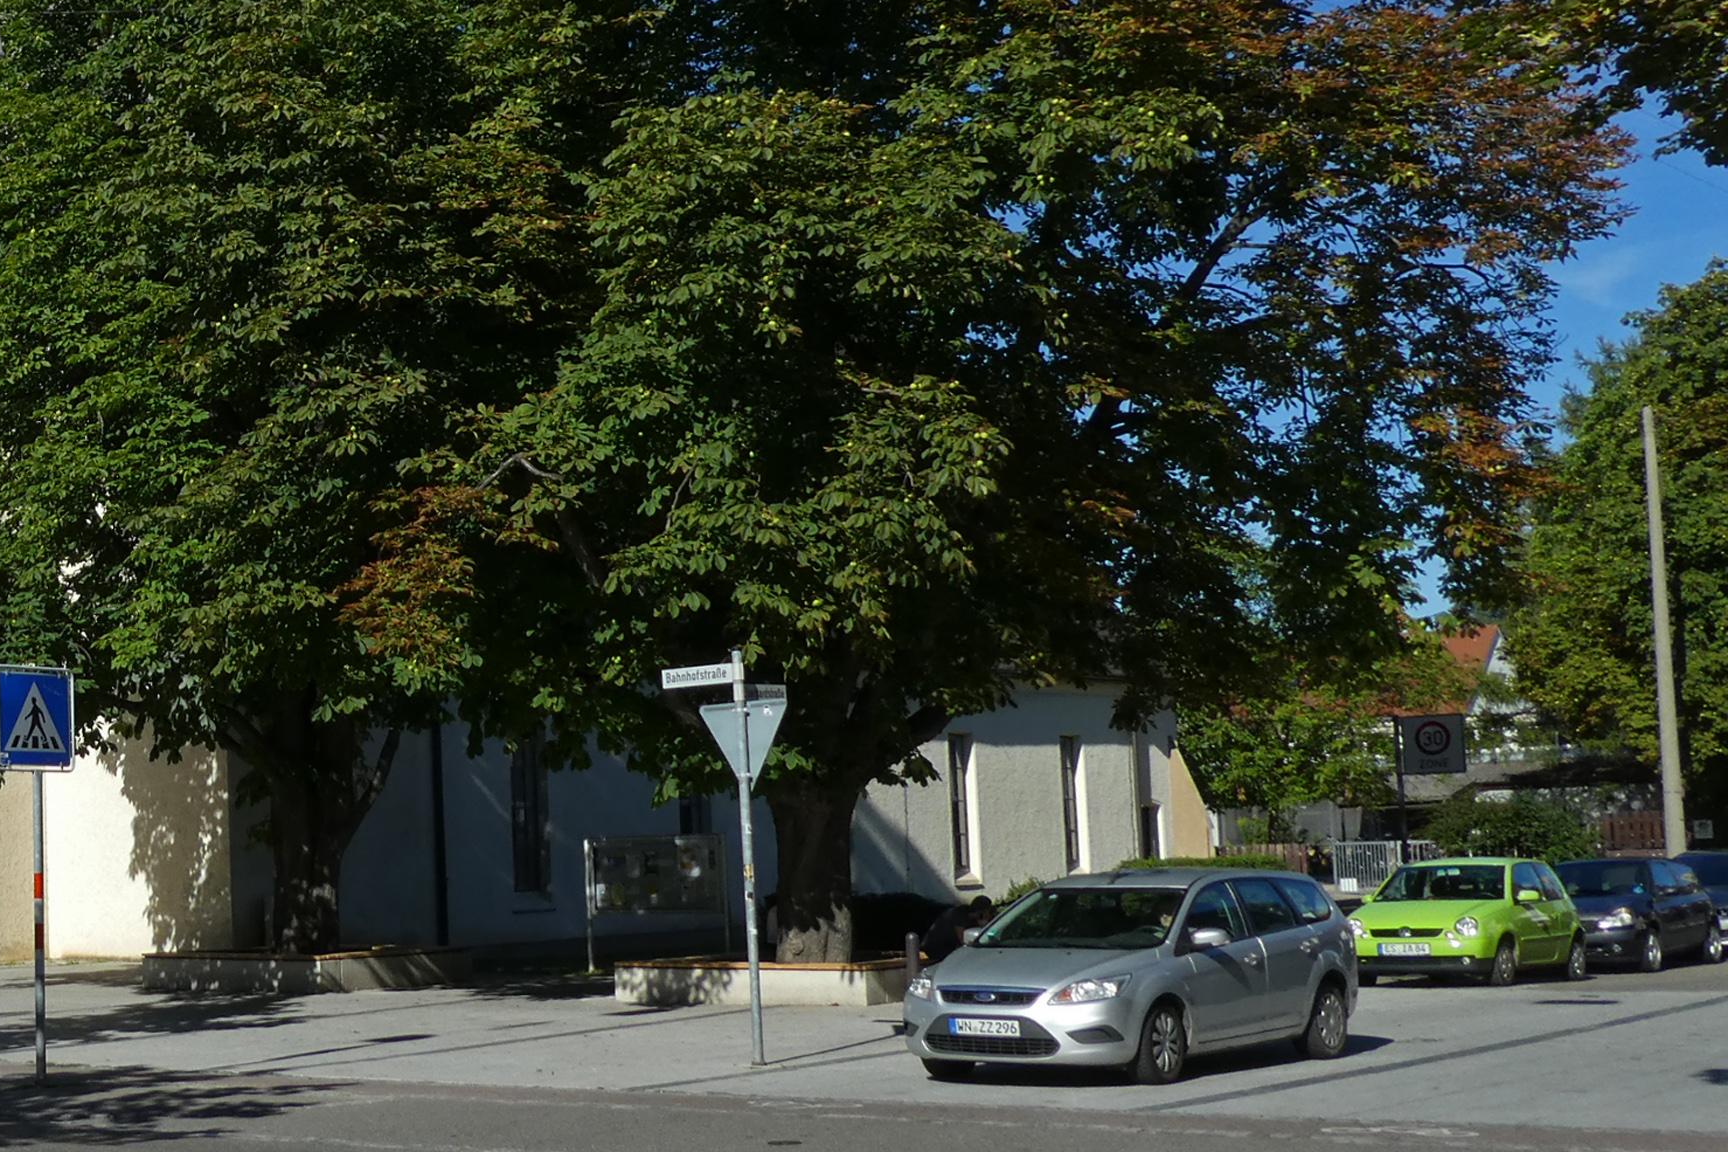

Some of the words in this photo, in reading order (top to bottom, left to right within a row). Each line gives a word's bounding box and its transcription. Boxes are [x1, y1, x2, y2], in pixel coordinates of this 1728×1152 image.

[665, 667, 727, 684] Bahnhofstraße
[1423, 730, 1444, 747] 30
[1417, 757, 1449, 769] ZONE
[957, 1020, 972, 1033] WN
[978, 1020, 994, 1034] ZZ
[995, 1021, 1018, 1034] 296
